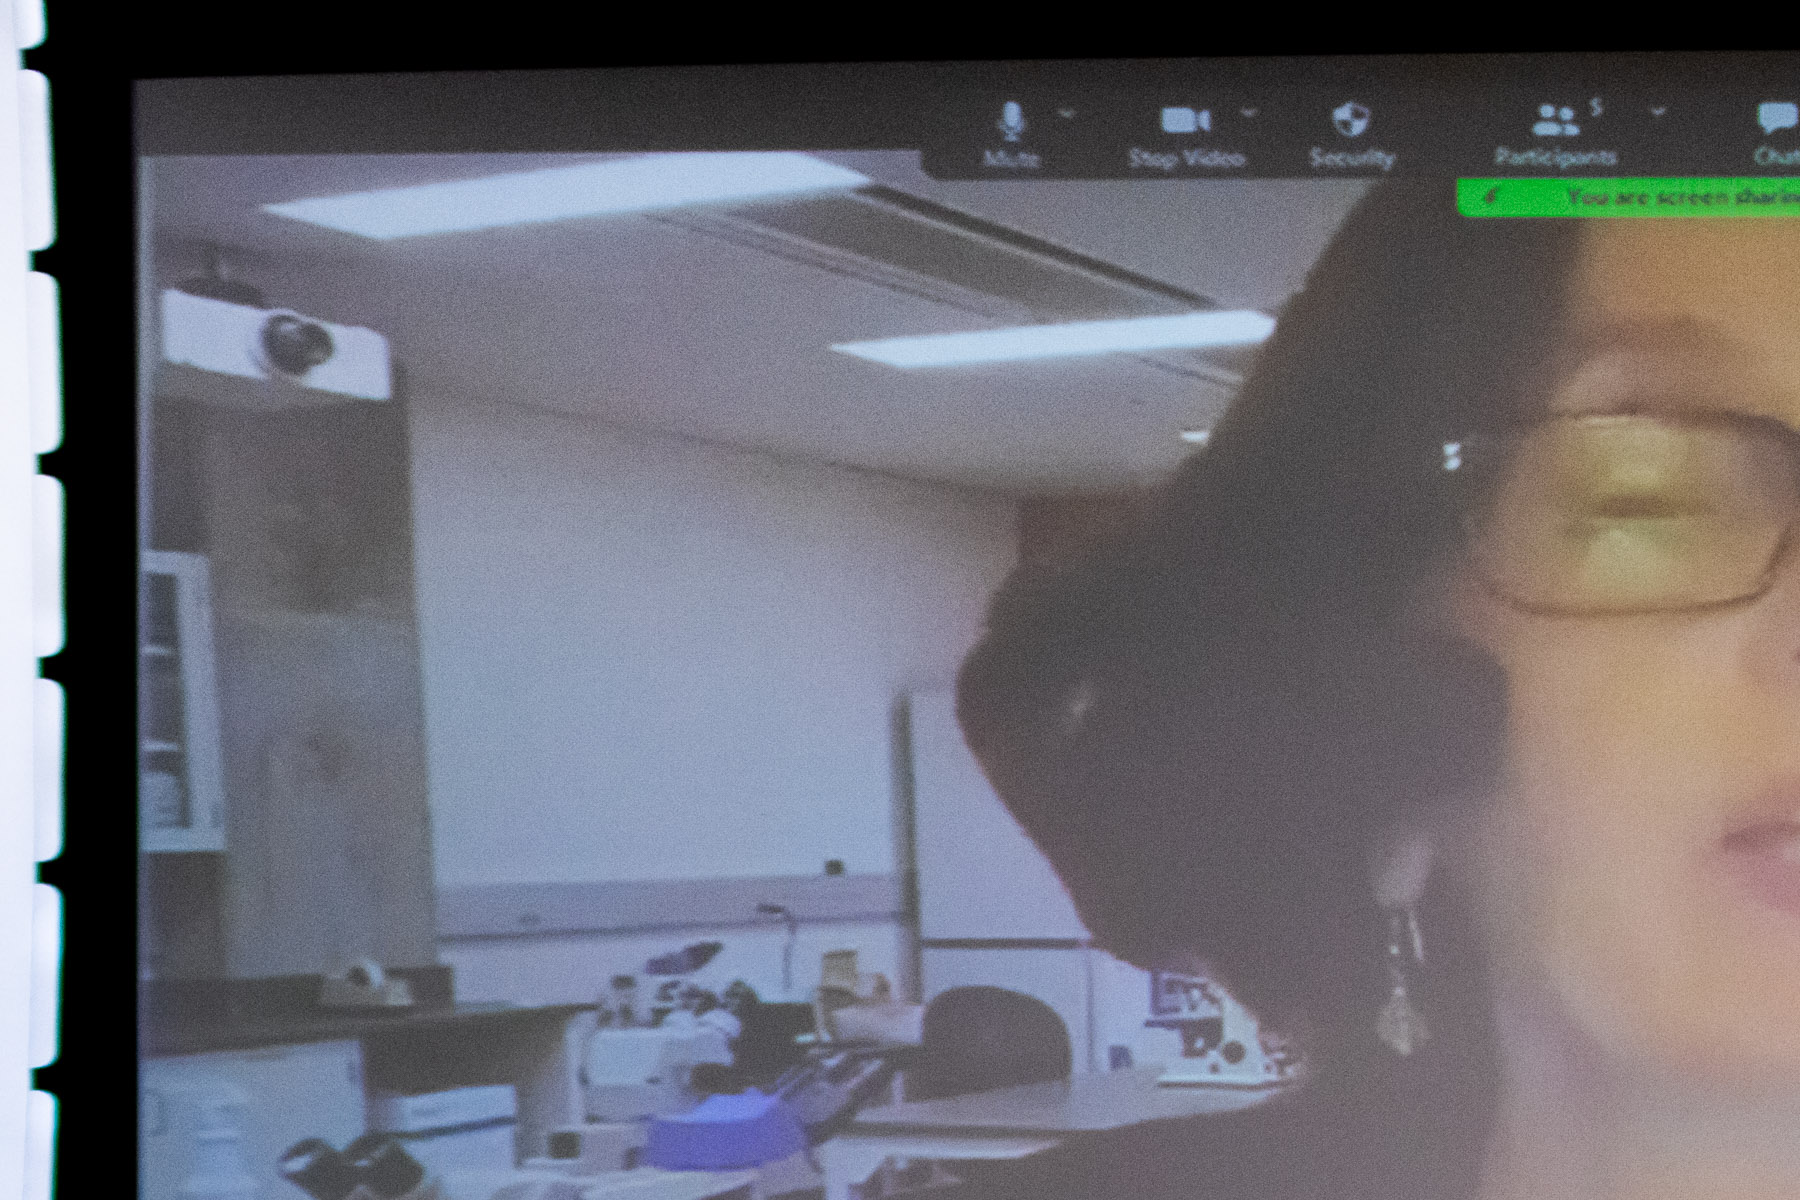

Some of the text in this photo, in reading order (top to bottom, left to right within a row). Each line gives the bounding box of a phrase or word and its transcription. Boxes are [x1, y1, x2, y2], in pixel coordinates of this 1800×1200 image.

[983, 149, 1041, 168] Mute
[1128, 148, 1247, 170] Stop Video
[1309, 146, 1396, 171] Security
[1494, 146, 1618, 169] Participants
[1567, 187, 1609, 206] You
[1614, 191, 1649, 206] are
[1656, 191, 1729, 206] screen
